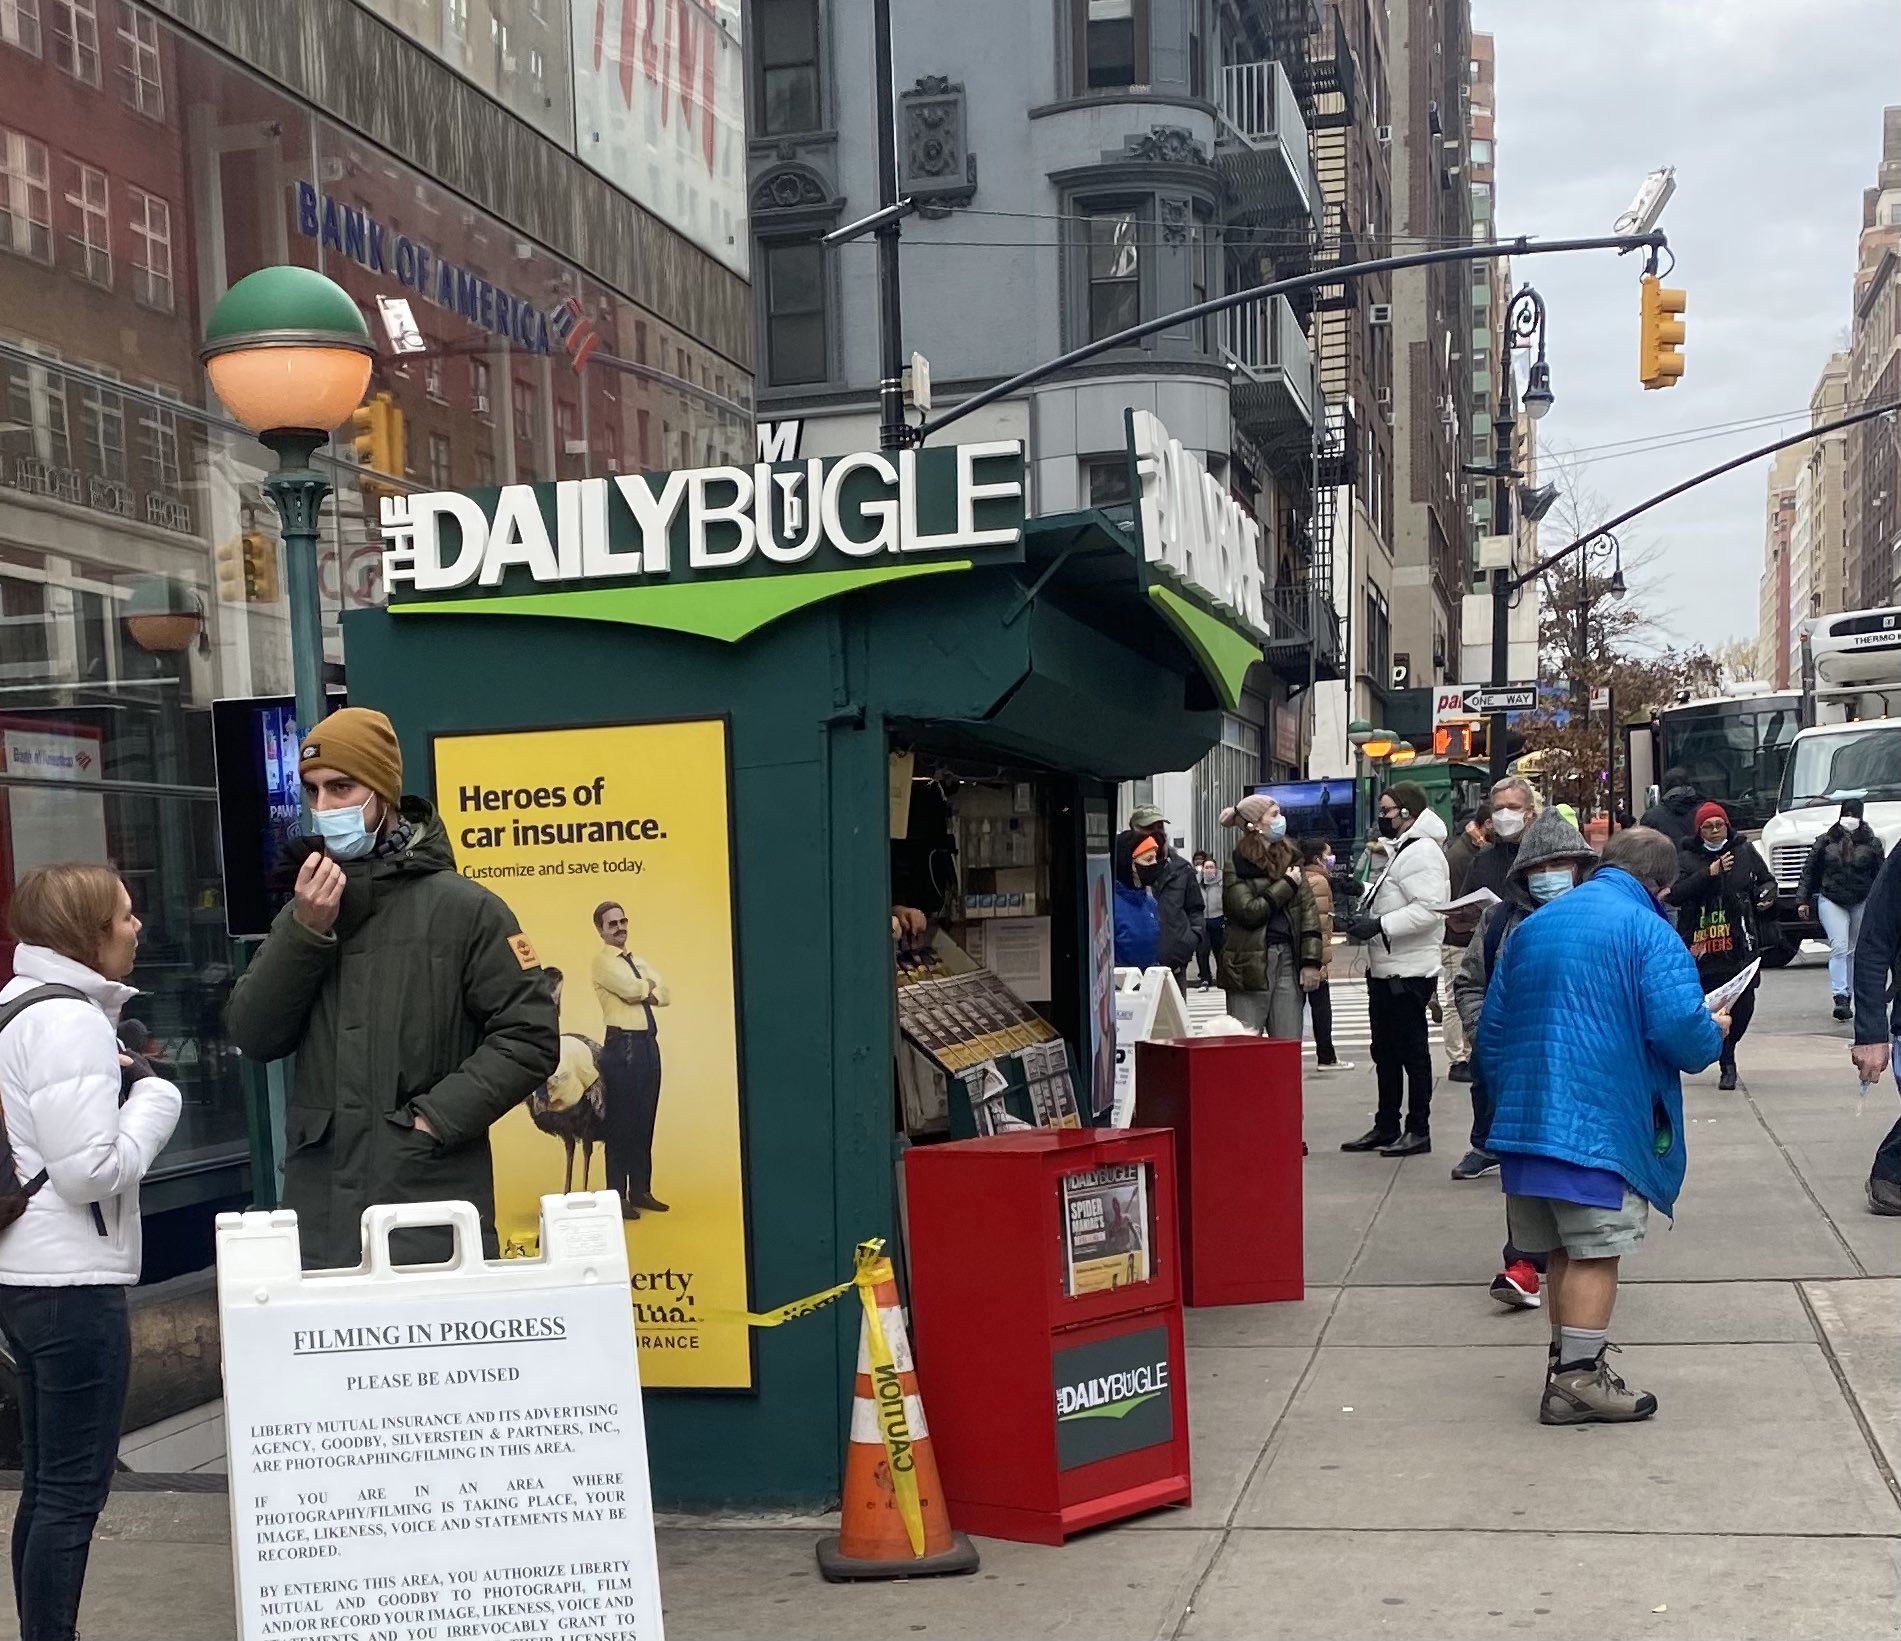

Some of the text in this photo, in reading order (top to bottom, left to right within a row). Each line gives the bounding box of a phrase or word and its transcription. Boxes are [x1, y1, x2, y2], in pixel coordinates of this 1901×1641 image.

[295, 180, 550, 355] BANK OF AMERICA
[380, 495, 415, 595] THE
[1854, 633, 1895, 645] THERMO
[1472, 694, 1531, 706] ONE WAY
[459, 776, 605, 813] Heroes of
[270, 804, 294, 819] PAW
[461, 818, 667, 849] car insurance.
[463, 857, 646, 879] Customize and save today.
[1070, 1198, 1103, 1220] SPIDER
[631, 1268, 694, 1301] erty
[293, 1316, 566, 1350] FILMING IN PROGRESS
[637, 1335, 699, 1349] RANCE
[347, 1367, 520, 1390] PLEASE BE ADVISED
[251, 1404, 618, 1438] LIBERTY MUTUAL INSURANCE AND ITS ADVERTISING
[252, 1421, 621, 1455] AGENCY, GOODBY, SILVERSTEIN & PARTNERS, INC.,
[253, 1442, 576, 1473] ARE PHOTOGRAPHING/FILMING IN THIS AREA.
[254, 1473, 624, 1508] IF YOU ARE IN AN AREA WHERE
[256, 1490, 626, 1526] PHOTOGRAPHY/FILMING IS TAKING PLACE, YOUR
[256, 1508, 627, 1545] IMAGE, LIKENESS, VOICE AND STATEMENTS MAY BE
[258, 1545, 341, 1562] RECORDED.
[260, 1560, 630, 1598] BY ENTERING THIS AREA, YOU AUTHORIZE LIBERTY
[261, 1578, 632, 1616] MUTUAL AND GOODBY TO PHOTOGRAPH, FILM
[262, 1595, 634, 1634] AND/OR RECORD YOUR IMAGE, LIKENESS, VOICE AND
[368, 1630, 398, 1641] AND
[407, 1627, 438, 1641] YOU
[448, 1619, 549, 1638] IRREVOCABLY
[558, 1615, 607, 1630] GRANT
[617, 1613, 635, 1626] TO
